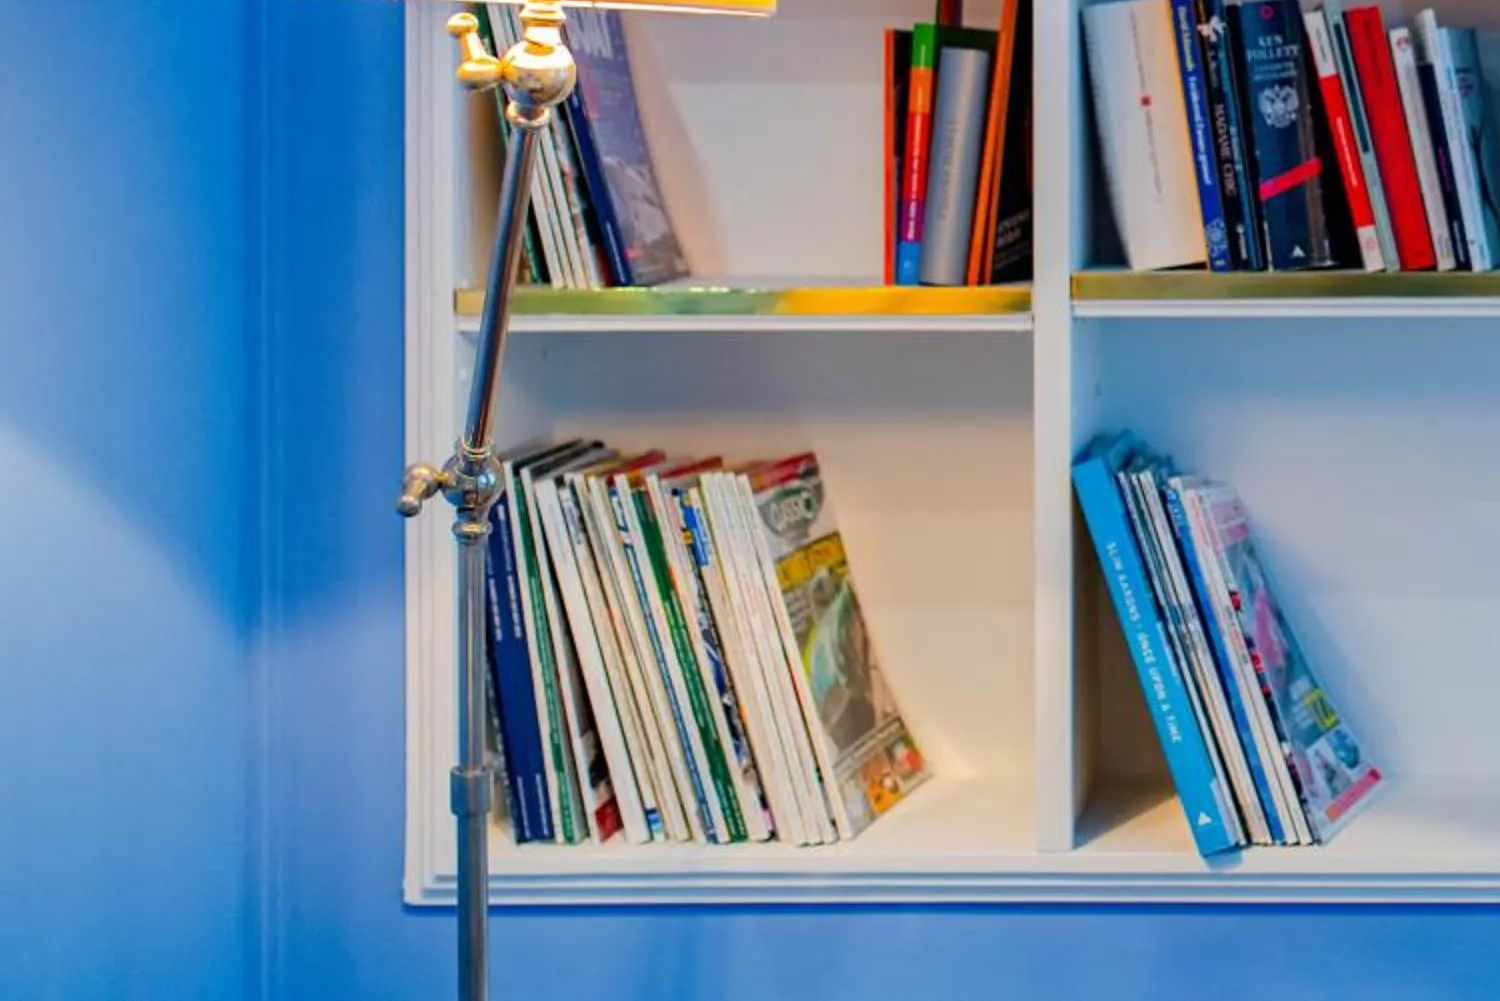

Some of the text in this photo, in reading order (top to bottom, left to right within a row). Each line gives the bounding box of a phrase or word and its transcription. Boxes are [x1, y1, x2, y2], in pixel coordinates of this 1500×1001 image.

[1104, 541, 1183, 744] SLIM AARONS ONCE UPON A TIME
